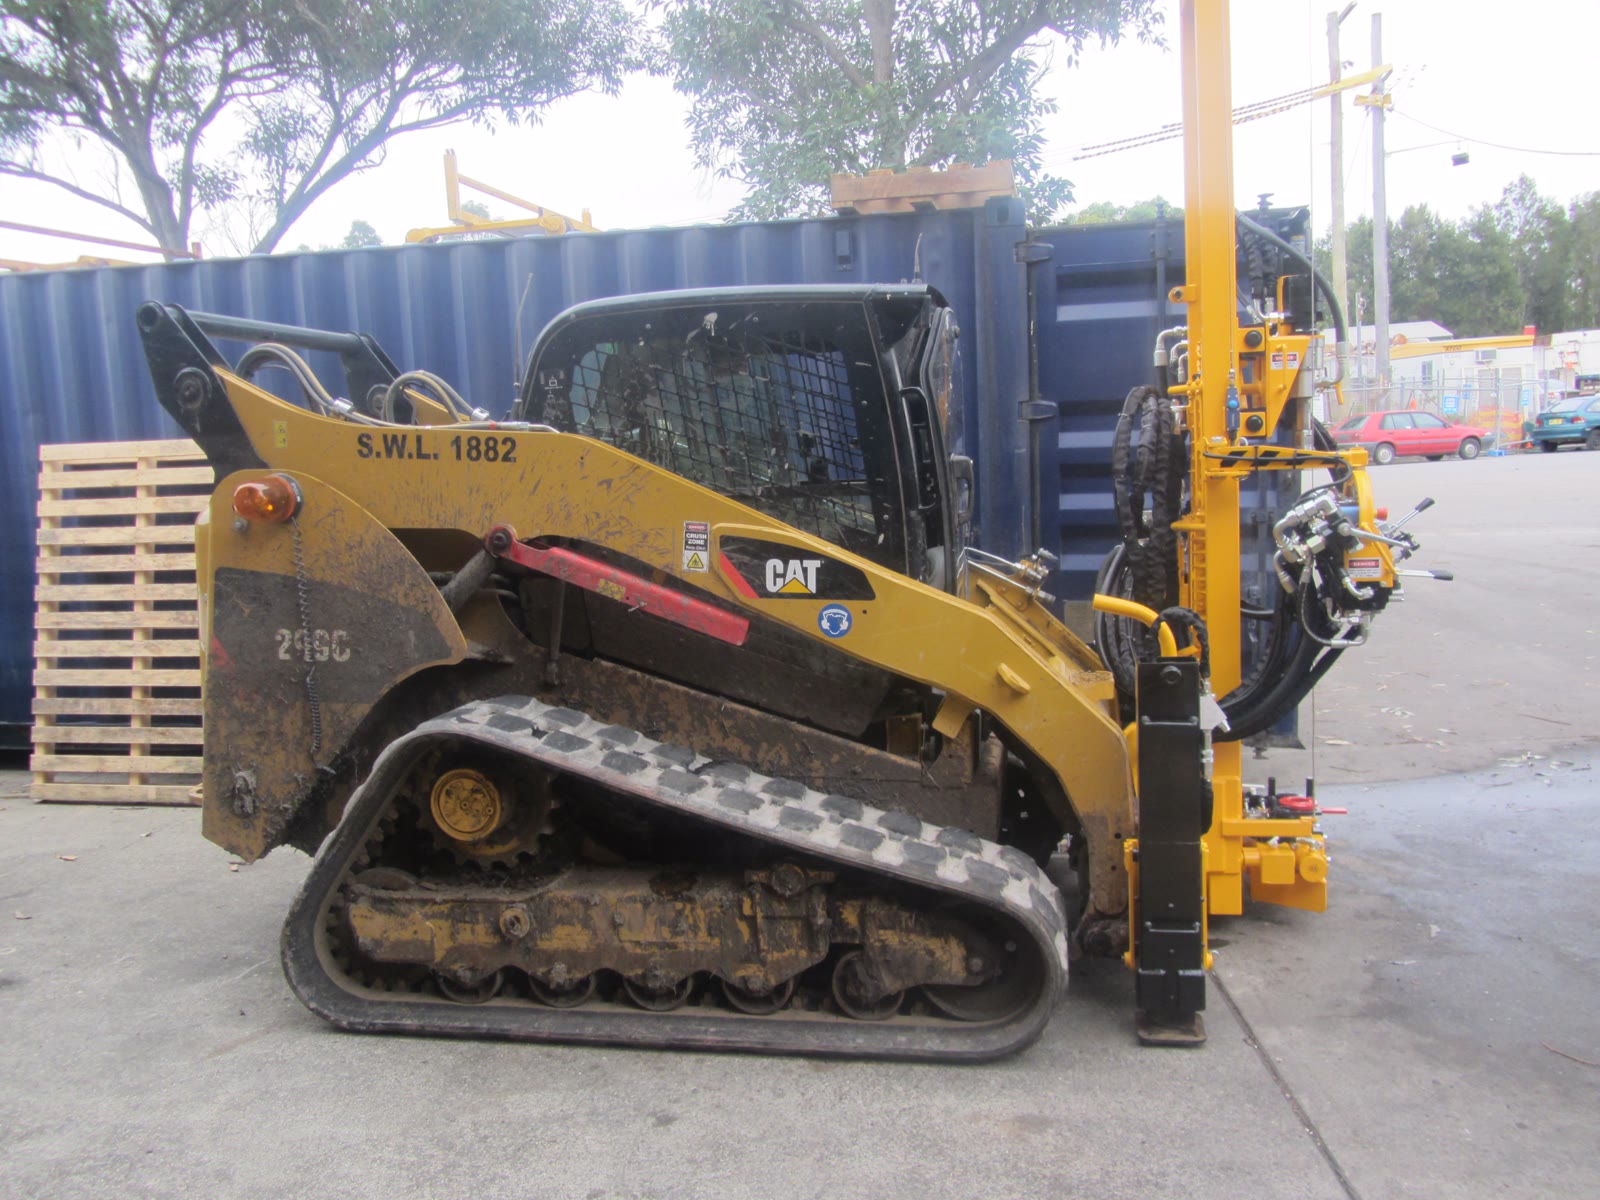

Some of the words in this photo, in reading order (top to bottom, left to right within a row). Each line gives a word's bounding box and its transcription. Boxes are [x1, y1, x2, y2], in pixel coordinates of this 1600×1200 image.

[357, 432, 439, 460] S.W.L.
[451, 436, 517, 463] 1882
[765, 558, 821, 594] CAT
